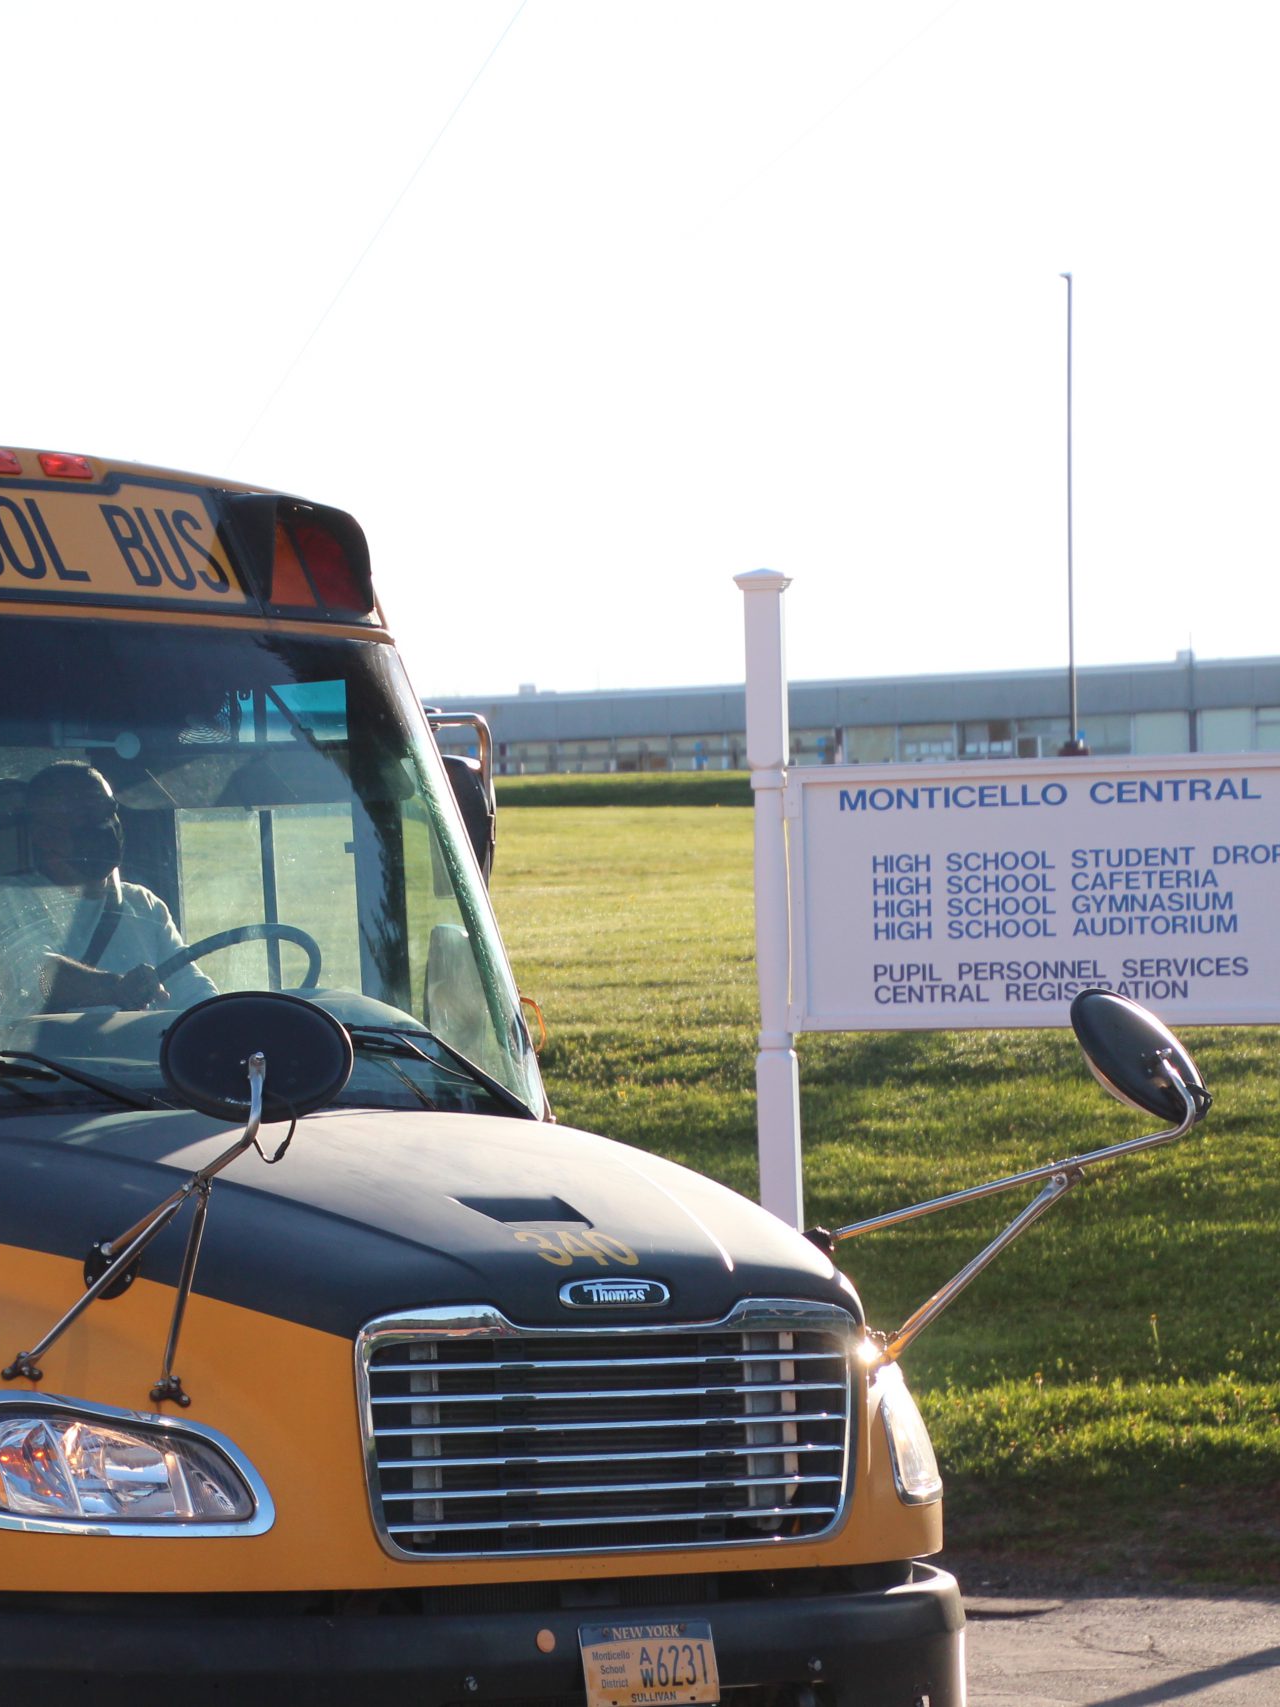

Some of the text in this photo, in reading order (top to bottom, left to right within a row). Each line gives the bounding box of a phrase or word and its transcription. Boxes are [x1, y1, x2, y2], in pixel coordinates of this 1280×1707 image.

[99, 504, 230, 593] BUS
[839, 778, 1262, 812] MONTICELLO CENTRAL
[872, 854, 931, 874] HIGH
[945, 850, 1056, 873] SCHOOL
[1071, 846, 1195, 869] STUDENT
[873, 869, 1219, 896] HIGH SCHOOL CAFETERIA
[873, 891, 1234, 918] HIGH SCHOOL GYMNASIUM
[874, 914, 1238, 941] HIGH SCHOOL AUDITORIUM
[873, 956, 1249, 983] PUPIL PERSONNEL SERVICES
[874, 983, 990, 1004] CENTRAL
[514, 1231, 640, 1267] 340
[583, 1283, 651, 1304] Thomas
[611, 1624, 680, 1640] NEW YORK
[592, 1650, 631, 1662] Monticello
[600, 1664, 626, 1675] School
[656, 1643, 708, 1688] 6231
[601, 1678, 629, 1689] District
[631, 1691, 677, 1703] SULLIVAN
